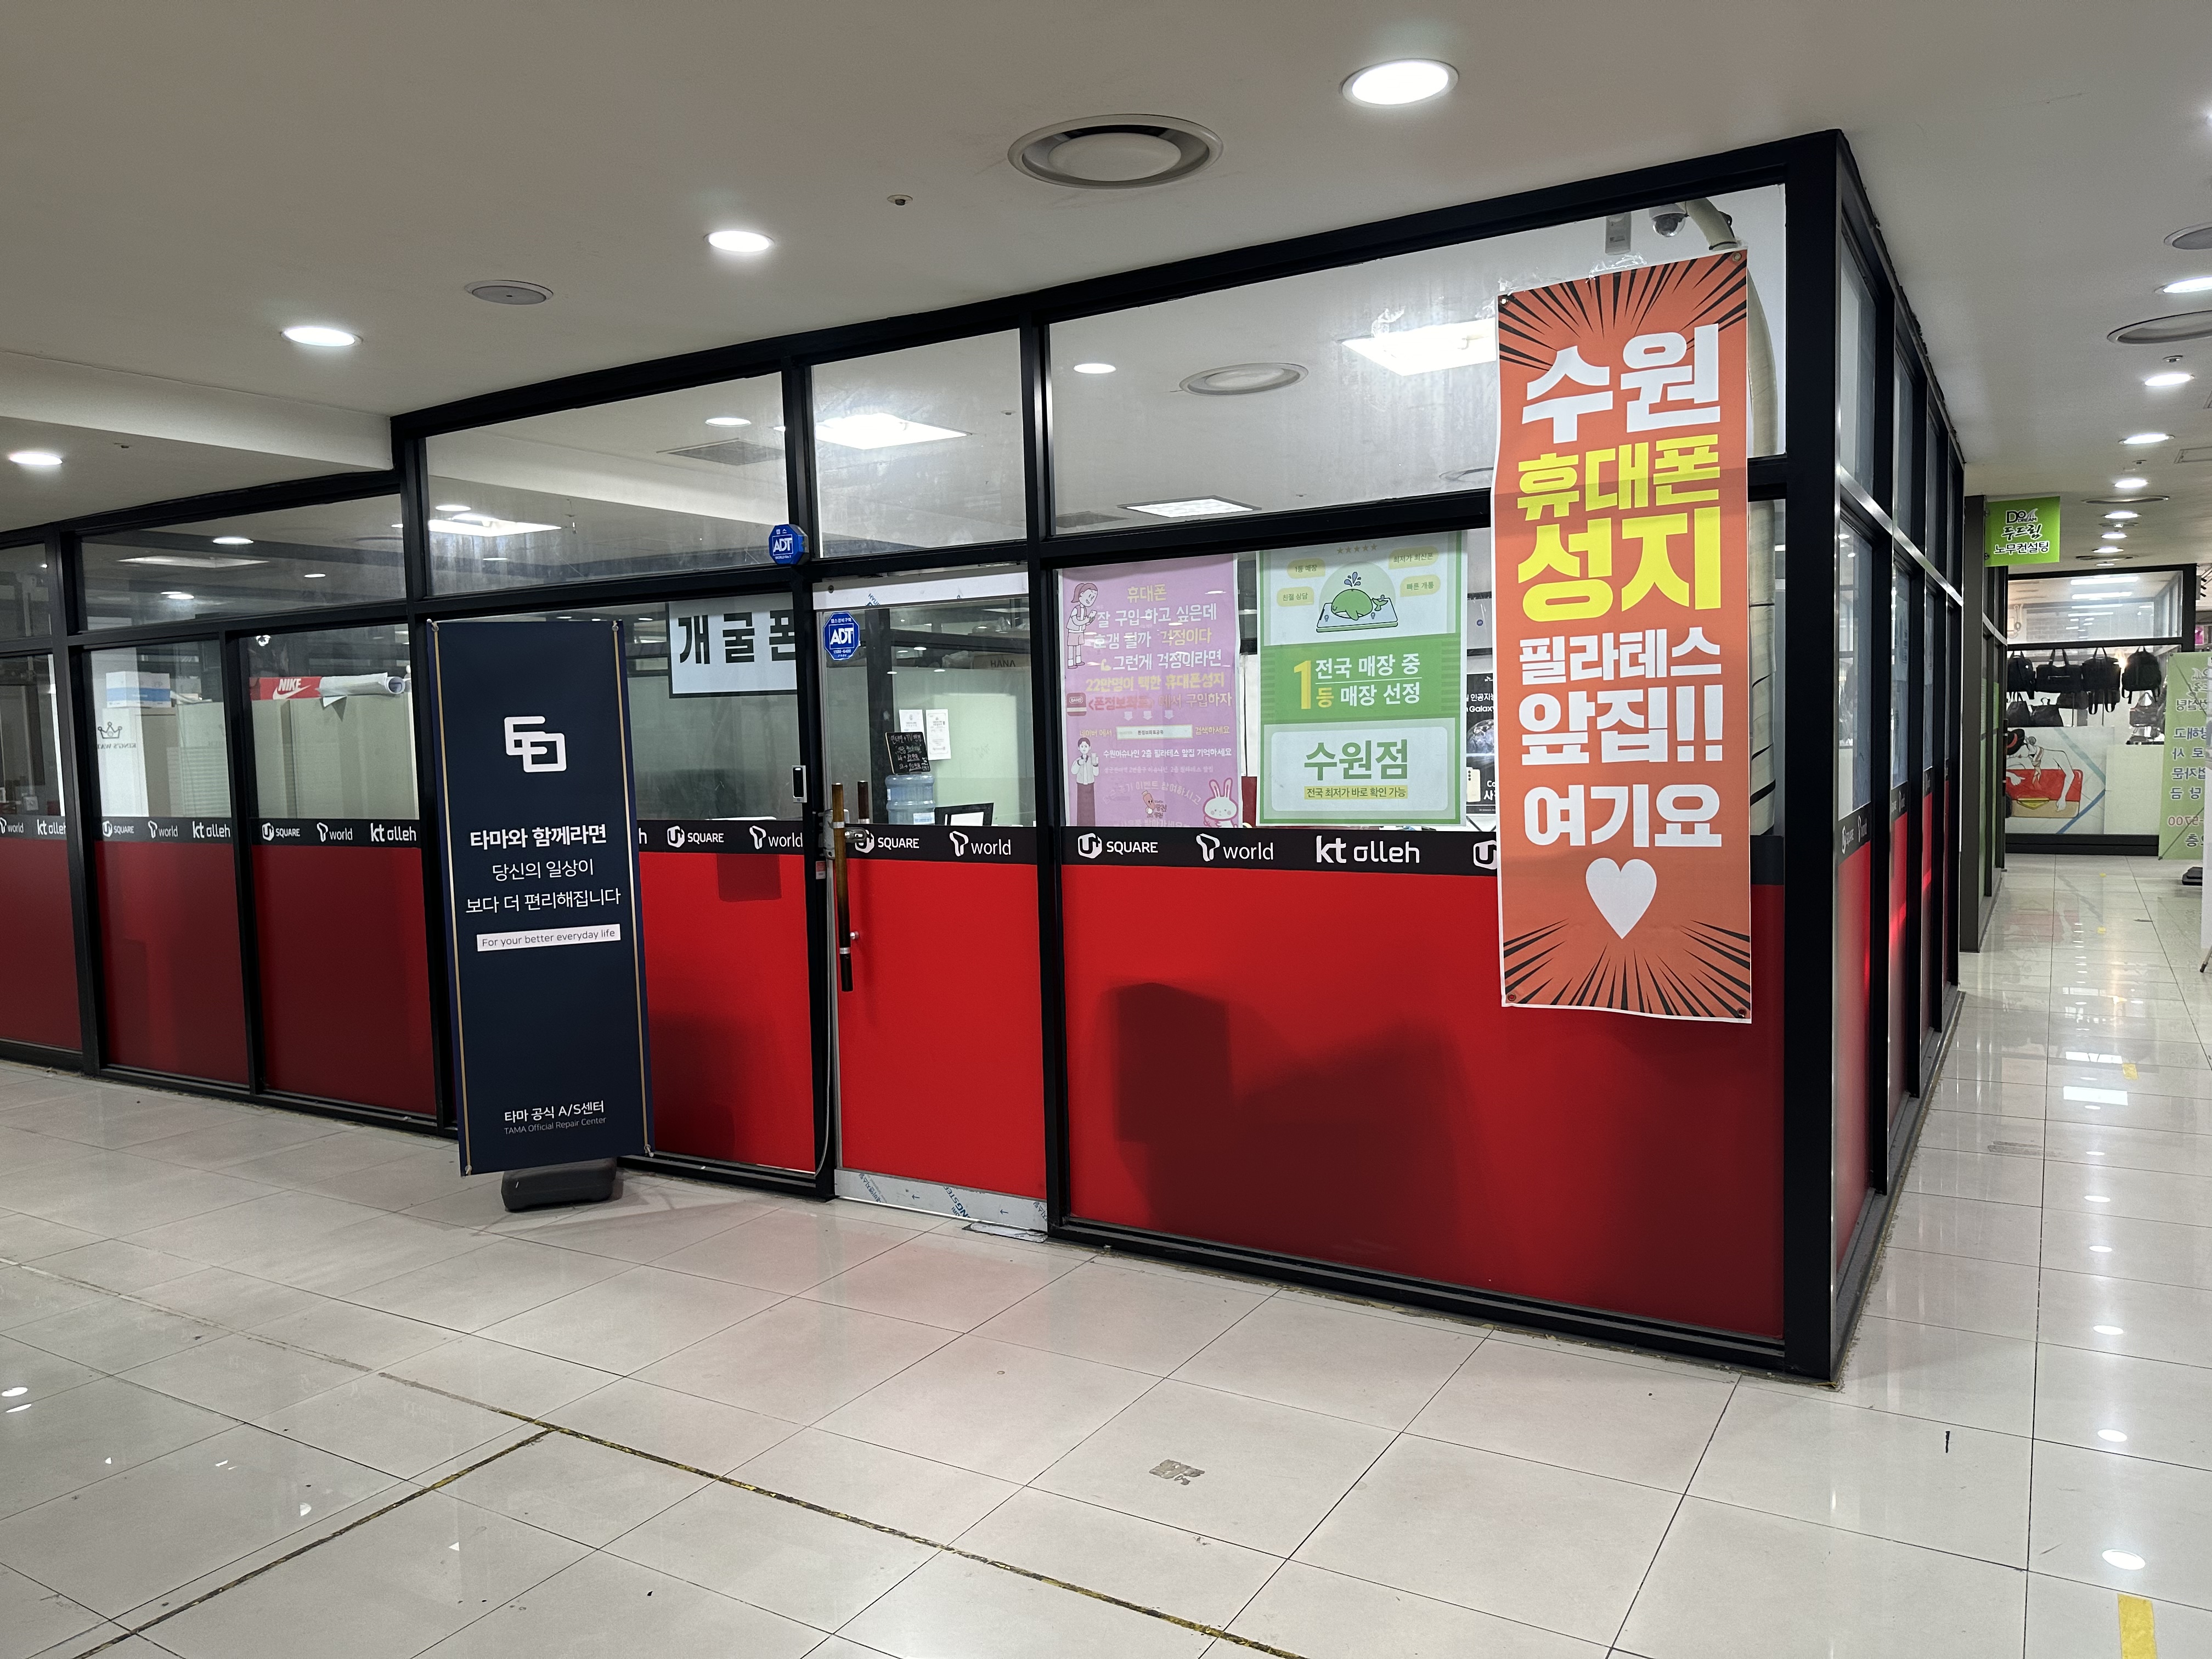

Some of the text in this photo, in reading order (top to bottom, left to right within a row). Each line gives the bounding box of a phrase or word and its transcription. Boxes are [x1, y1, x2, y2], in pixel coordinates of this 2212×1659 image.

[1522, 323, 1721, 444] 수원
[1517, 434, 1721, 521] 휴대폰
[773, 538, 792, 552] ADT
[1994, 541, 2049, 554] 노무컨설팅
[1393, 552, 1434, 563] 최저가 최신폰
[1518, 506, 1722, 622] 성지
[868, 593, 880, 606] HYU
[1127, 584, 1167, 603] 휴대폰
[1296, 592, 1308, 601] 상담
[1097, 611, 1110, 628] 잘
[1115, 610, 1139, 627] 구입
[1176, 603, 1217, 622] 싶은데
[830, 628, 854, 645] ADT
[1160, 627, 1212, 646] 걱정이다
[990, 659, 1015, 668] HANA
[1113, 650, 1221, 671] 그런게 걱정이라면
[1519, 627, 1722, 685] 필라테스
[1315, 658, 1352, 679] 전국
[1358, 654, 1395, 676] 매장
[1401, 653, 1420, 674] 중
[278, 679, 301, 691] NIKE
[1165, 672, 1224, 689] 휴대폰성지
[1186, 692, 1232, 707] 구입하자
[1316, 682, 1420, 707] 등 매장 선정
[1195, 726, 1229, 735] 검색하세요
[1519, 684, 1724, 765] 앞집!!
[1154, 749, 1180, 758] 필라테스
[1182, 749, 1195, 757] 앞집
[1197, 748, 1232, 757] 기억하세요
[1304, 739, 1407, 781] 수원점
[1136, 781, 1159, 790] 이벤트
[1307, 787, 1406, 798] 전국 최저가 바로 확인 가능
[1523, 783, 1722, 848] 여기요
[8, 822, 24, 833] world
[37, 819, 47, 835] kt
[114, 826, 134, 834] SQUARE
[158, 824, 178, 837] world
[192, 821, 205, 838] kt
[206, 825, 230, 838] olleh
[275, 828, 301, 837] SQUARE
[329, 828, 353, 840] world
[370, 823, 385, 842] kt
[387, 826, 416, 842] olleh
[470, 823, 607, 850] 타마와 함께라면
[687, 832, 724, 844] SQUARE
[768, 832, 803, 847] world
[878, 837, 919, 850] SQUARE
[971, 838, 1011, 855] world
[1107, 841, 1159, 854] SQUARE
[1223, 843, 1273, 860] world
[1317, 835, 1346, 864] kt
[1353, 841, 1420, 864] olleh
[492, 858, 594, 882] 당신의 일상이
[466, 888, 621, 913] 보다 더 편리해집니다
[482, 928, 615, 947] For your better everyday life
[504, 1100, 604, 1124] 타마 공식 A/S센터
[504, 1116, 606, 1135] TAMA Official Repair Center
